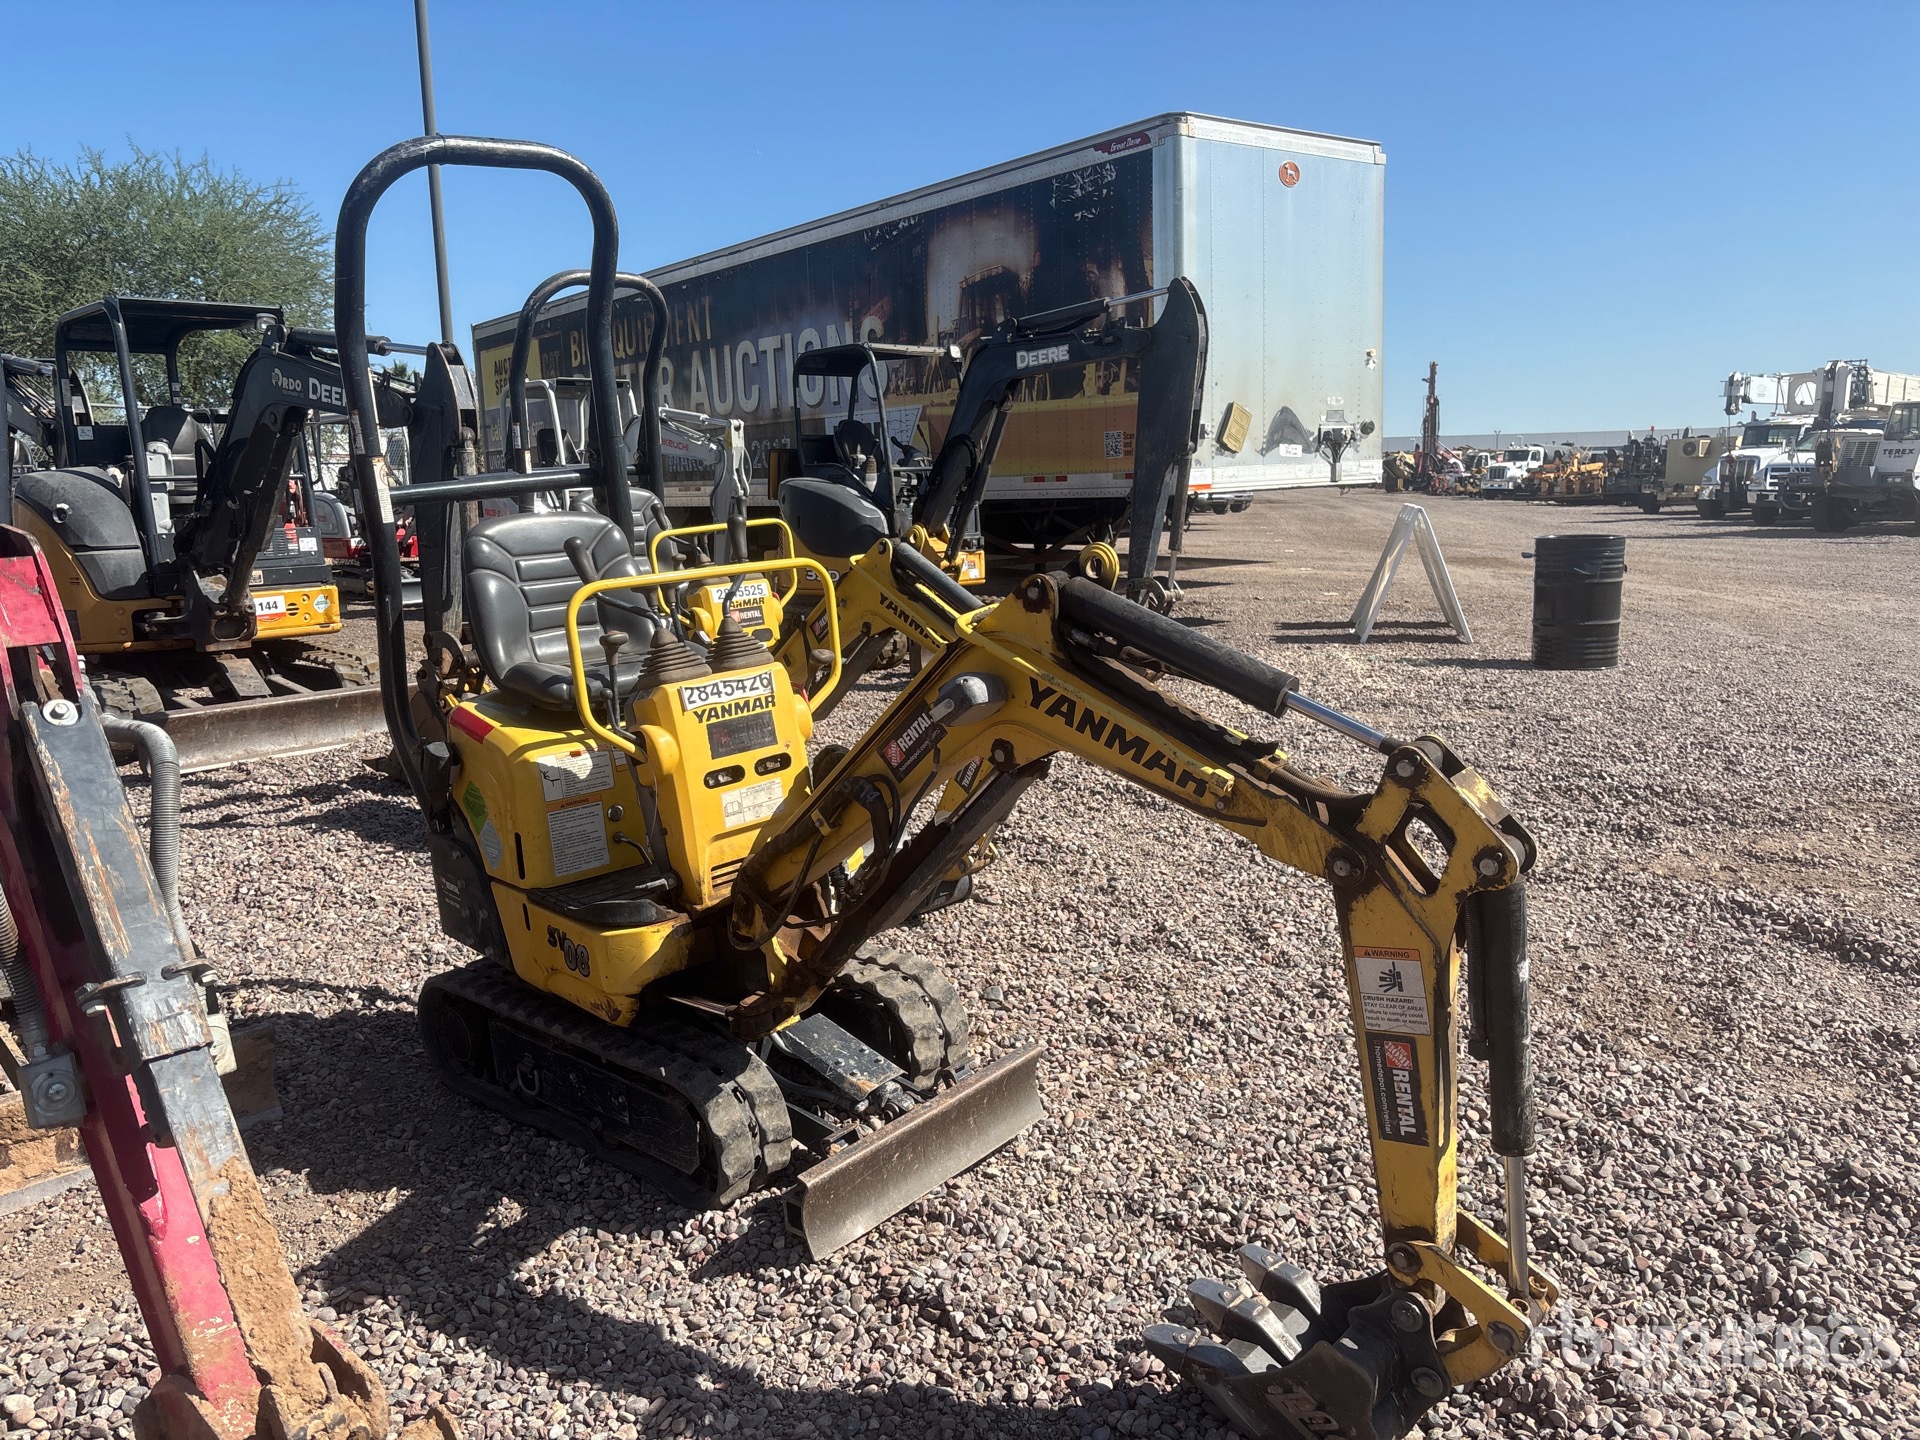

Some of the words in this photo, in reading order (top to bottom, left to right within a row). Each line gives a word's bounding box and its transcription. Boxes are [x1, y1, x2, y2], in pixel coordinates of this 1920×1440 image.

[1110, 141, 1126, 152] Great
[1126, 137, 1141, 147] Dane
[612, 296, 712, 359] QUIPENT
[689, 315, 889, 416] AUCTIONS
[1016, 344, 1070, 370] DEERE
[308, 377, 348, 407] DEE
[806, 568, 840, 581] 3D
[716, 584, 764, 600] 285525
[730, 597, 765, 608] ANMAR
[258, 600, 279, 611] 144
[740, 610, 762, 619] RENTAL
[693, 694, 776, 724] YANMAR
[897, 712, 933, 752] RENTAL
[1028, 676, 1211, 798] YANMAR
[565, 798, 589, 807] WARNING
[1371, 951, 1410, 959] WARNING
[1386, 997, 1414, 1005] HAZARD!
[1385, 1042, 1411, 1068] HOME
[1386, 1051, 1402, 1069] DEPOT
[1374, 1046, 1393, 1135] homedepot.com/rental
[1392, 1069, 1417, 1136] RENTAL
